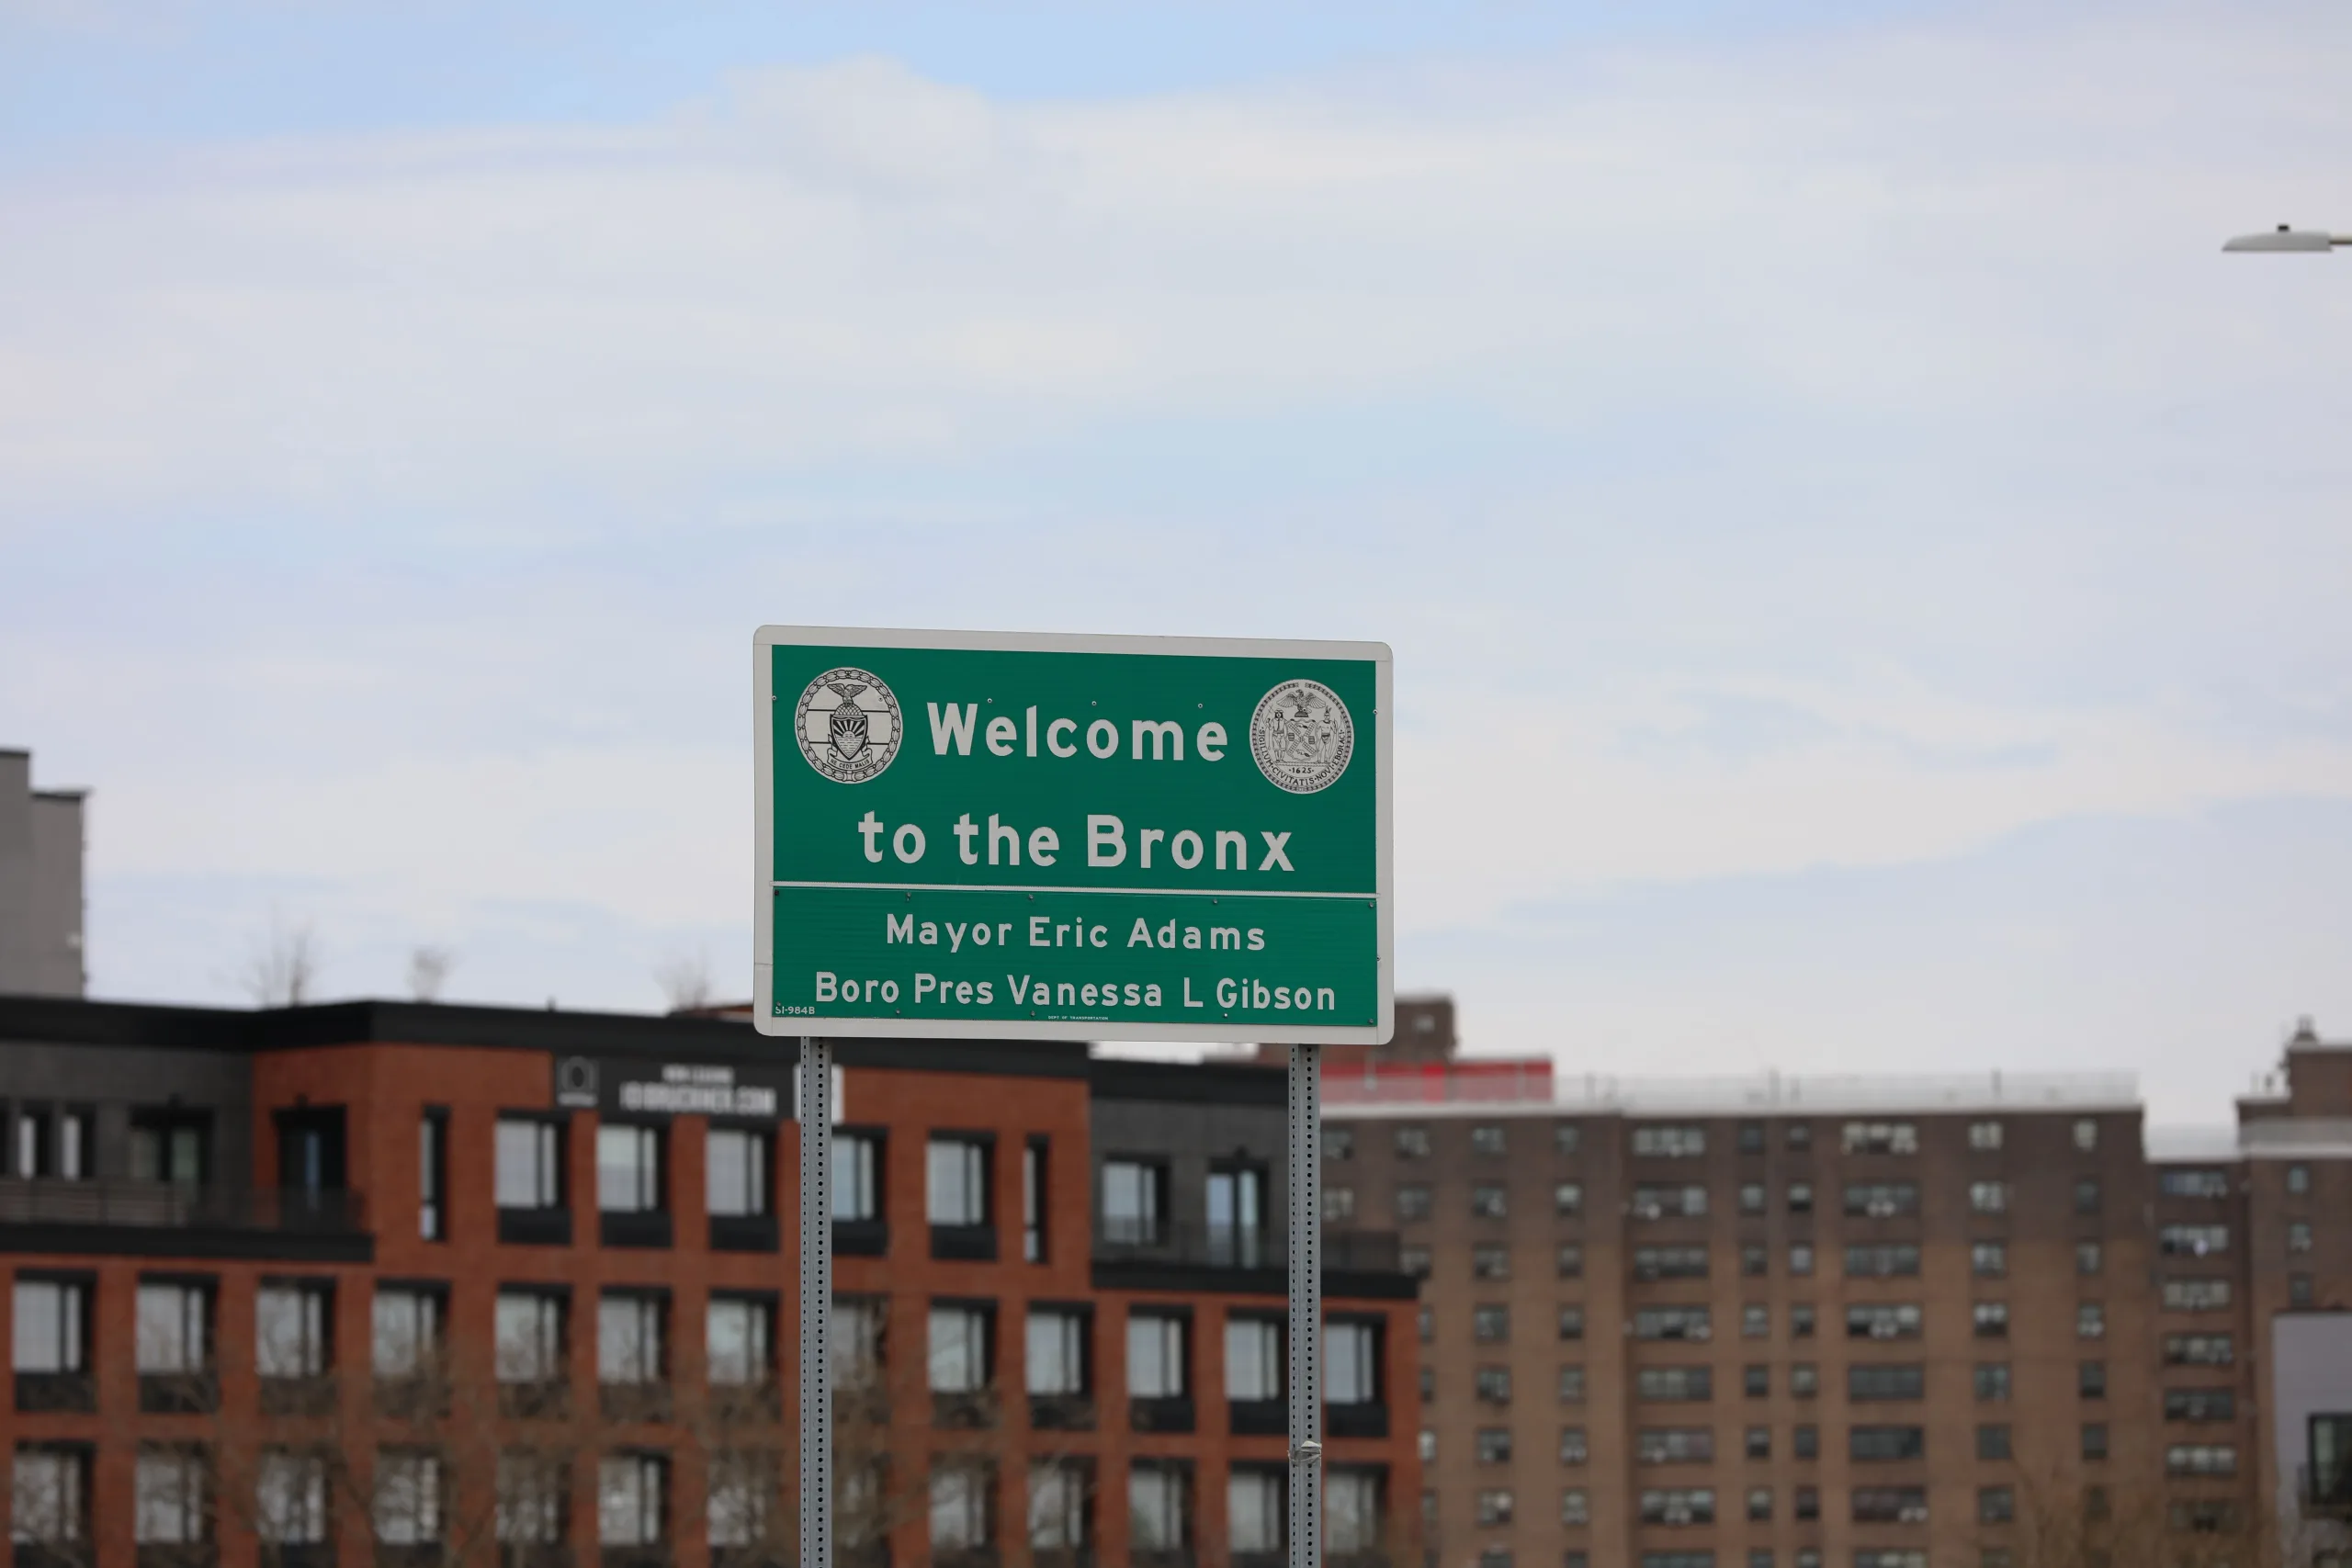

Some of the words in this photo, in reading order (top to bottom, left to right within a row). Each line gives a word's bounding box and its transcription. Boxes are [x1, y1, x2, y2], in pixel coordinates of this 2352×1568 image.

[926, 702, 1228, 761] Welcome
[854, 759, 870, 768] MALIS
[1272, 767, 1315, 785] CIVITATIS
[1316, 765, 1334, 781] NOVI
[857, 810, 926, 864] to
[953, 813, 1060, 867] the
[1087, 814, 1295, 872] Bronx
[887, 913, 1012, 953] Mayor
[1029, 916, 1108, 948] Eric
[1126, 918, 1265, 951] Adams
[816, 971, 899, 1003] Boro
[914, 973, 994, 1005] Pres
[1007, 975, 1162, 1007] Vanessa
[1183, 976, 1204, 1008] L
[1216, 977, 1335, 1010] Gibson
[775, 1006, 815, 1015] SI-984B
